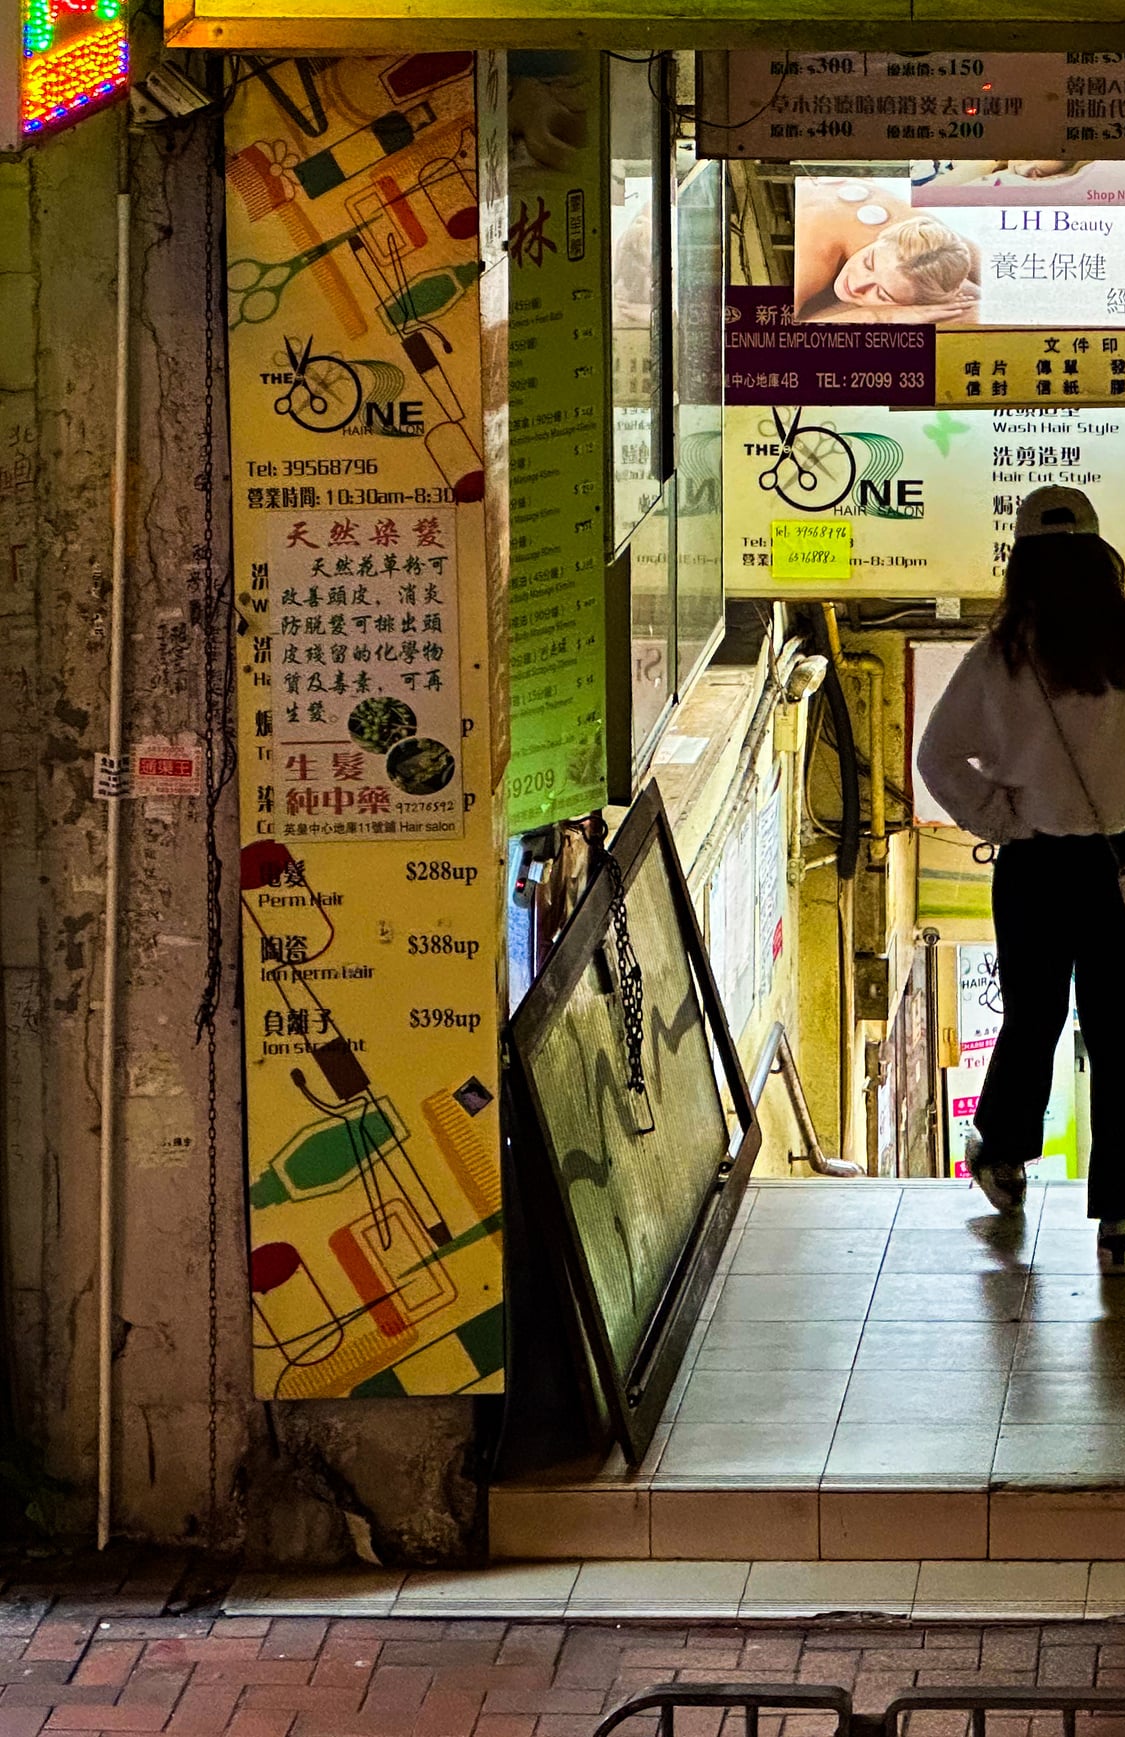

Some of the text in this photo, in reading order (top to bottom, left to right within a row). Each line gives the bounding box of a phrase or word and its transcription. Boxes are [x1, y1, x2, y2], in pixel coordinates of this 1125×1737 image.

[938, 121, 984, 139] $200
[1087, 189, 1115, 202] Shop
[1053, 210, 1113, 236] Beauty
[508, 195, 558, 269] 林
[989, 252, 1107, 282] 養生保健
[779, 331, 861, 349] EMPLOYMENT
[864, 331, 925, 349] SERVICES
[259, 371, 295, 384] THE
[850, 372, 893, 389] 27099
[899, 372, 925, 389] 333
[342, 425, 374, 437] HAIR
[992, 421, 1120, 436] Wash Hair Style
[744, 443, 780, 456] THE
[992, 446, 1081, 467] 洗剪造型
[246, 458, 378, 478] Tel: 39568796
[992, 471, 1102, 486] Hair Cut Style
[247, 486, 320, 509] 營業時間:
[833, 505, 867, 517] HAIR
[285, 786, 391, 817] 純中藥
[400, 822, 423, 833] Hair
[425, 821, 456, 833] salon
[406, 861, 478, 886] $288up
[258, 893, 306, 908] Perm
[408, 935, 480, 959] $388up
[961, 976, 987, 990] HAIR
[264, 1008, 481, 1037] 負離子 $398up
[263, 1041, 289, 1056] Ion
